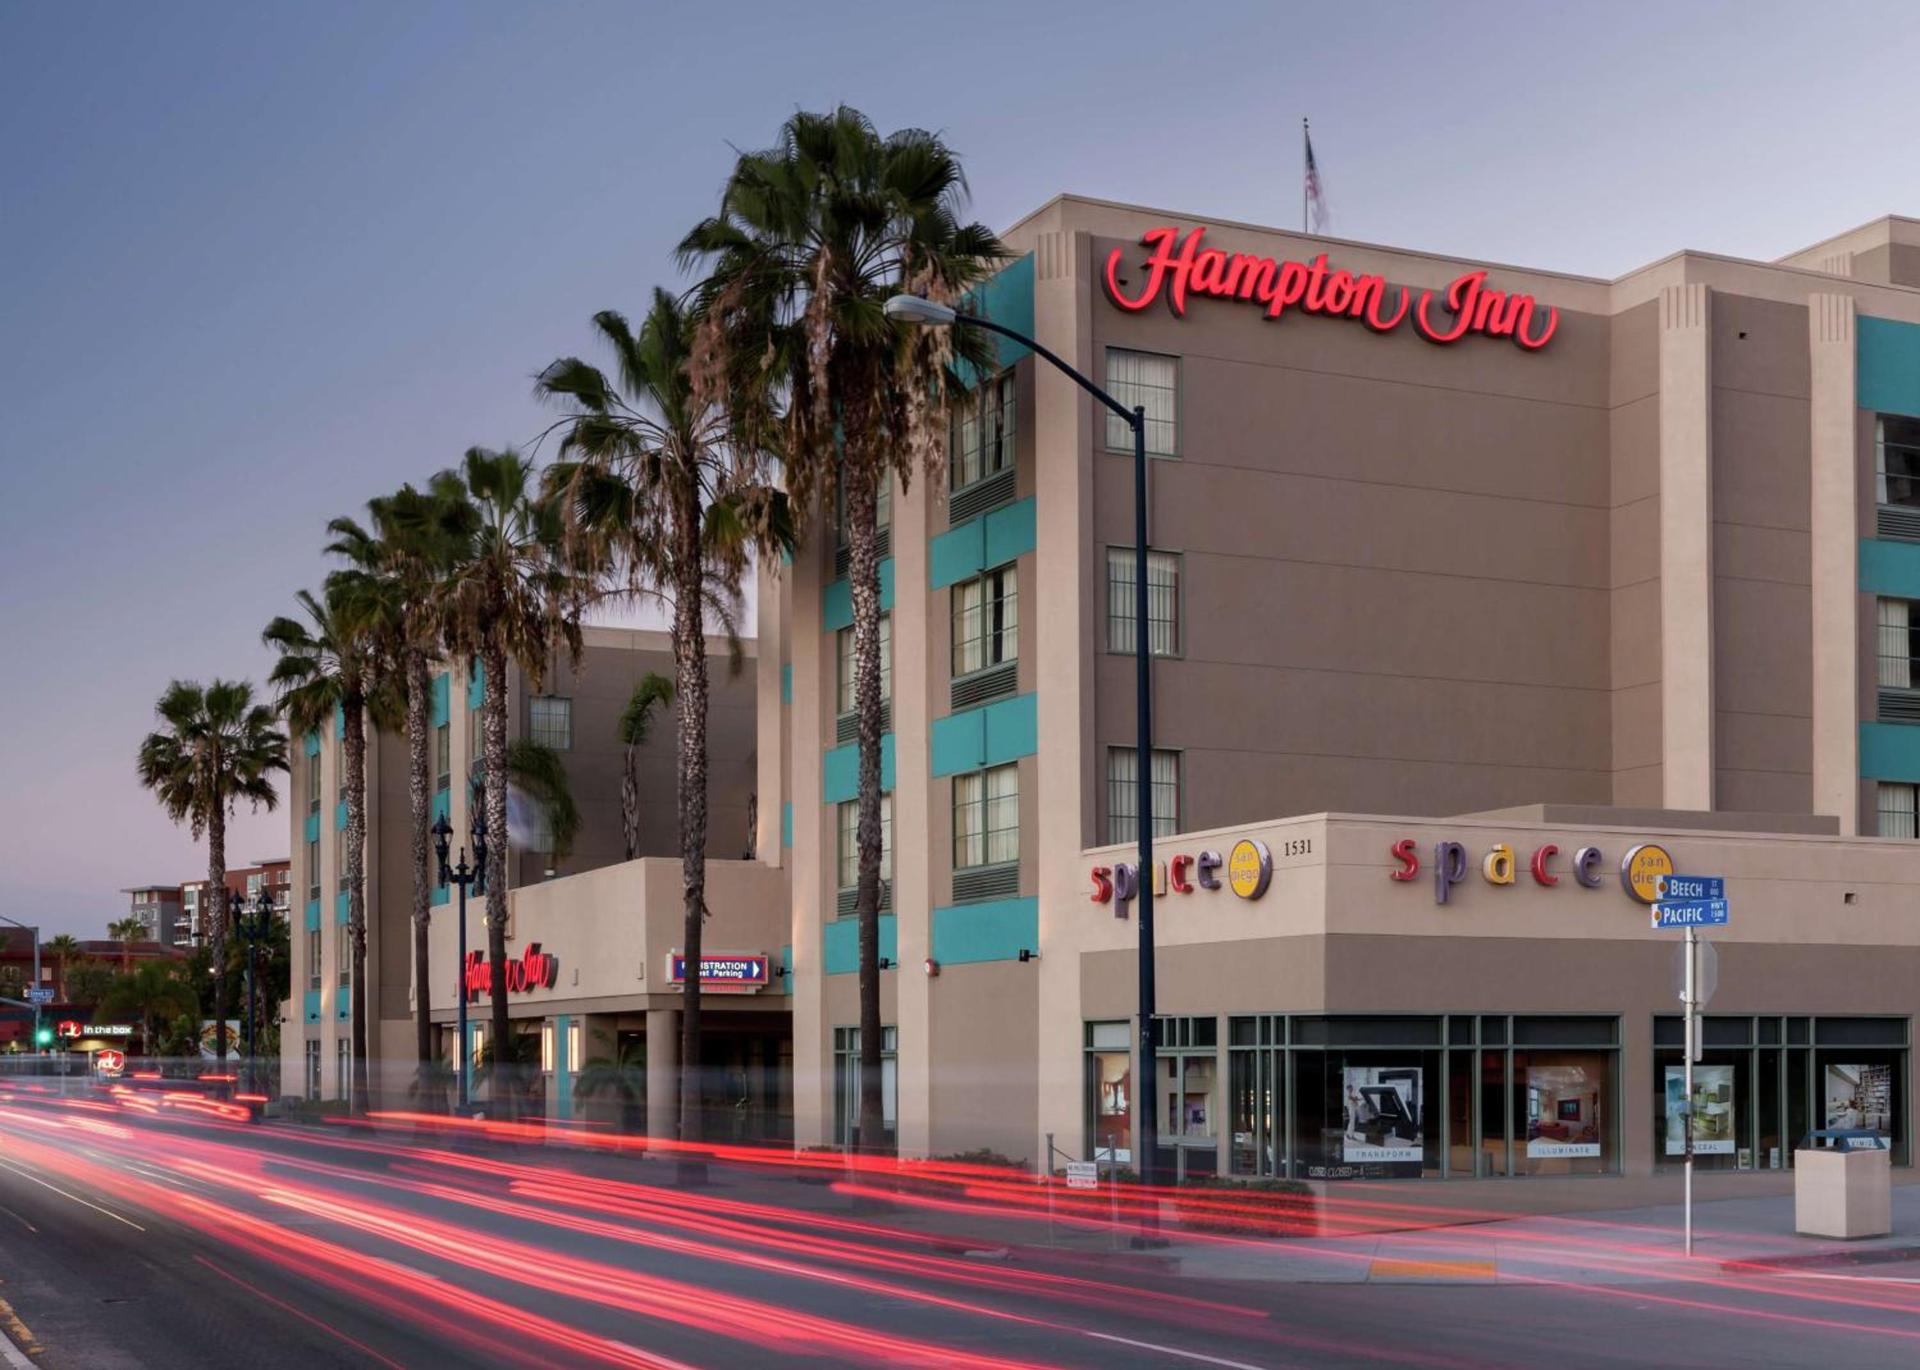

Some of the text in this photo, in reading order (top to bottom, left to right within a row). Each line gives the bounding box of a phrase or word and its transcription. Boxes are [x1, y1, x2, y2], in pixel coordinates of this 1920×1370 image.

[1104, 227, 1558, 350] Hampton Inn
[1285, 839, 1312, 856] 1531
[1641, 856, 1664, 867] san
[1391, 839, 1602, 904] space
[1633, 871, 1656, 884] die
[1091, 850, 1222, 919] spce
[1670, 879, 1703, 897] BEECH
[1663, 907, 1703, 924] PACIFIC
[713, 970, 743, 978] Parking
[95, 1024, 112, 1034] the
[113, 1024, 132, 1034] box
[1355, 1150, 1411, 1159] TRANSFORM
